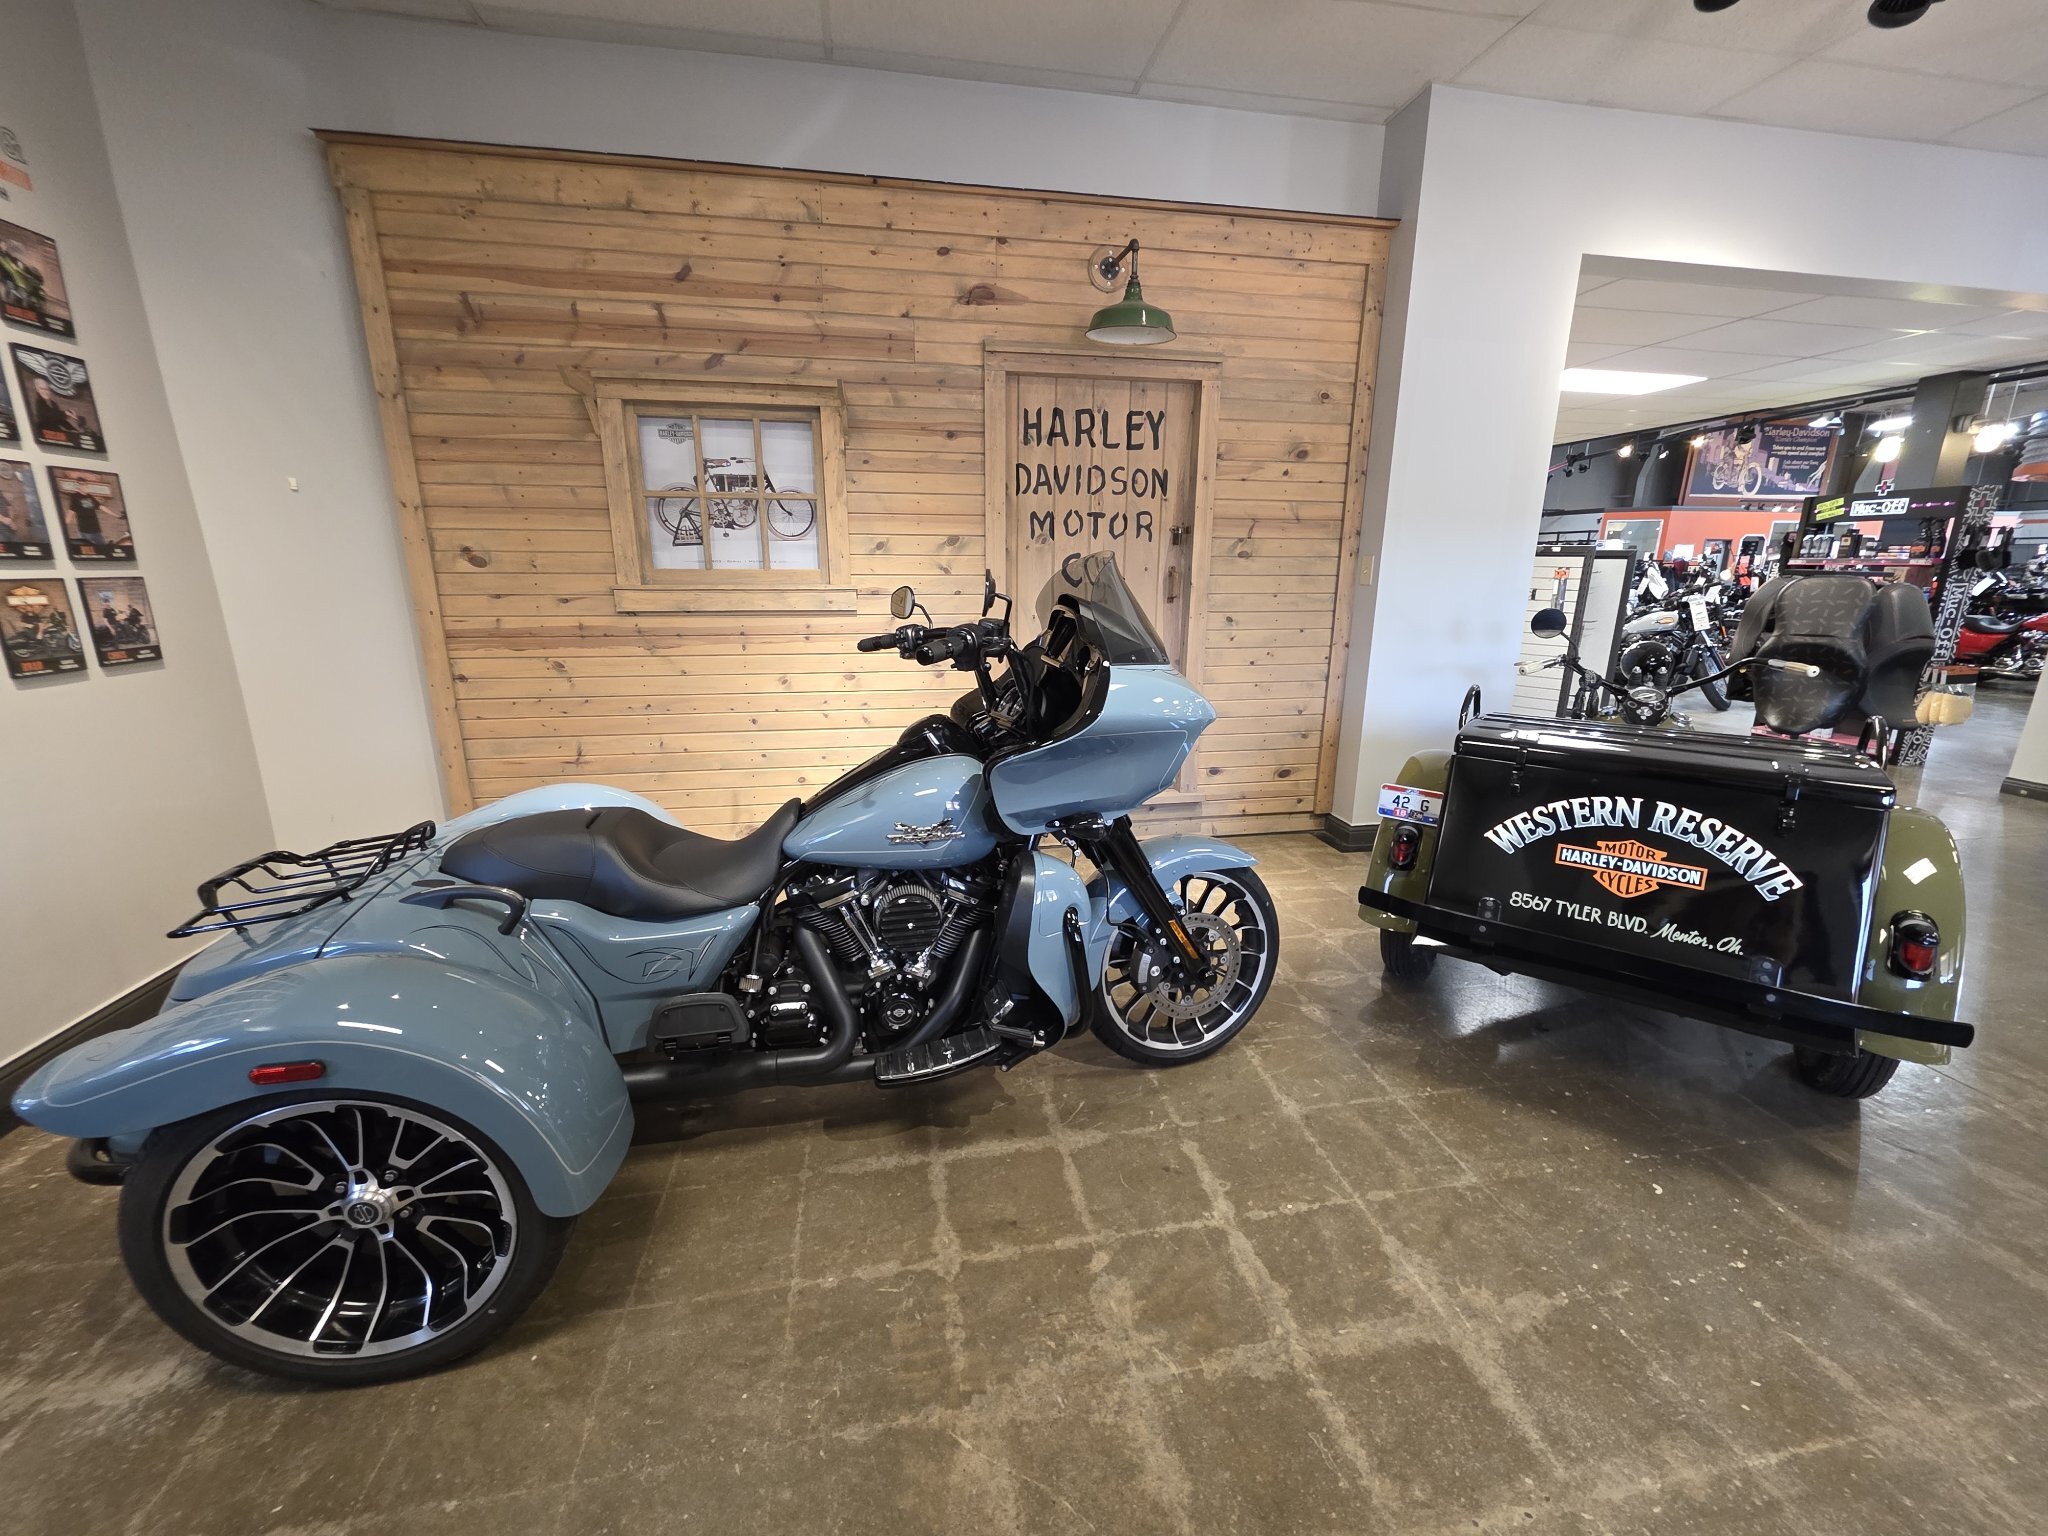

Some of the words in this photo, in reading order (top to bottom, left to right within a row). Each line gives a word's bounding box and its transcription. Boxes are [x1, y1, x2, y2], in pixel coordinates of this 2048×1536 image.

[1023, 407, 1165, 450] HARLEY
[1015, 462, 1168, 499] DAVIDSON
[1030, 509, 1153, 542] MOTOR
[1853, 500, 1905, 514] Muc-Off
[1934, 586, 1966, 659] Muc-Off
[1392, 795, 1411, 809] 42
[1420, 799, 1431, 812] G
[1484, 796, 1644, 854] WESTERN
[1647, 801, 1804, 902] RESERVE
[1561, 848, 1702, 885] HARLEY-DAVIDSON
[1605, 842, 1657, 861] MOTOR
[1600, 870, 1654, 895] CYCLES
[1509, 891, 1552, 913] 8567
[1555, 899, 1602, 925] TYLER
[1607, 911, 1648, 935] BLVD.
[1650, 922, 1713, 950] Mentor,
[1716, 936, 1744, 956] Oh.
